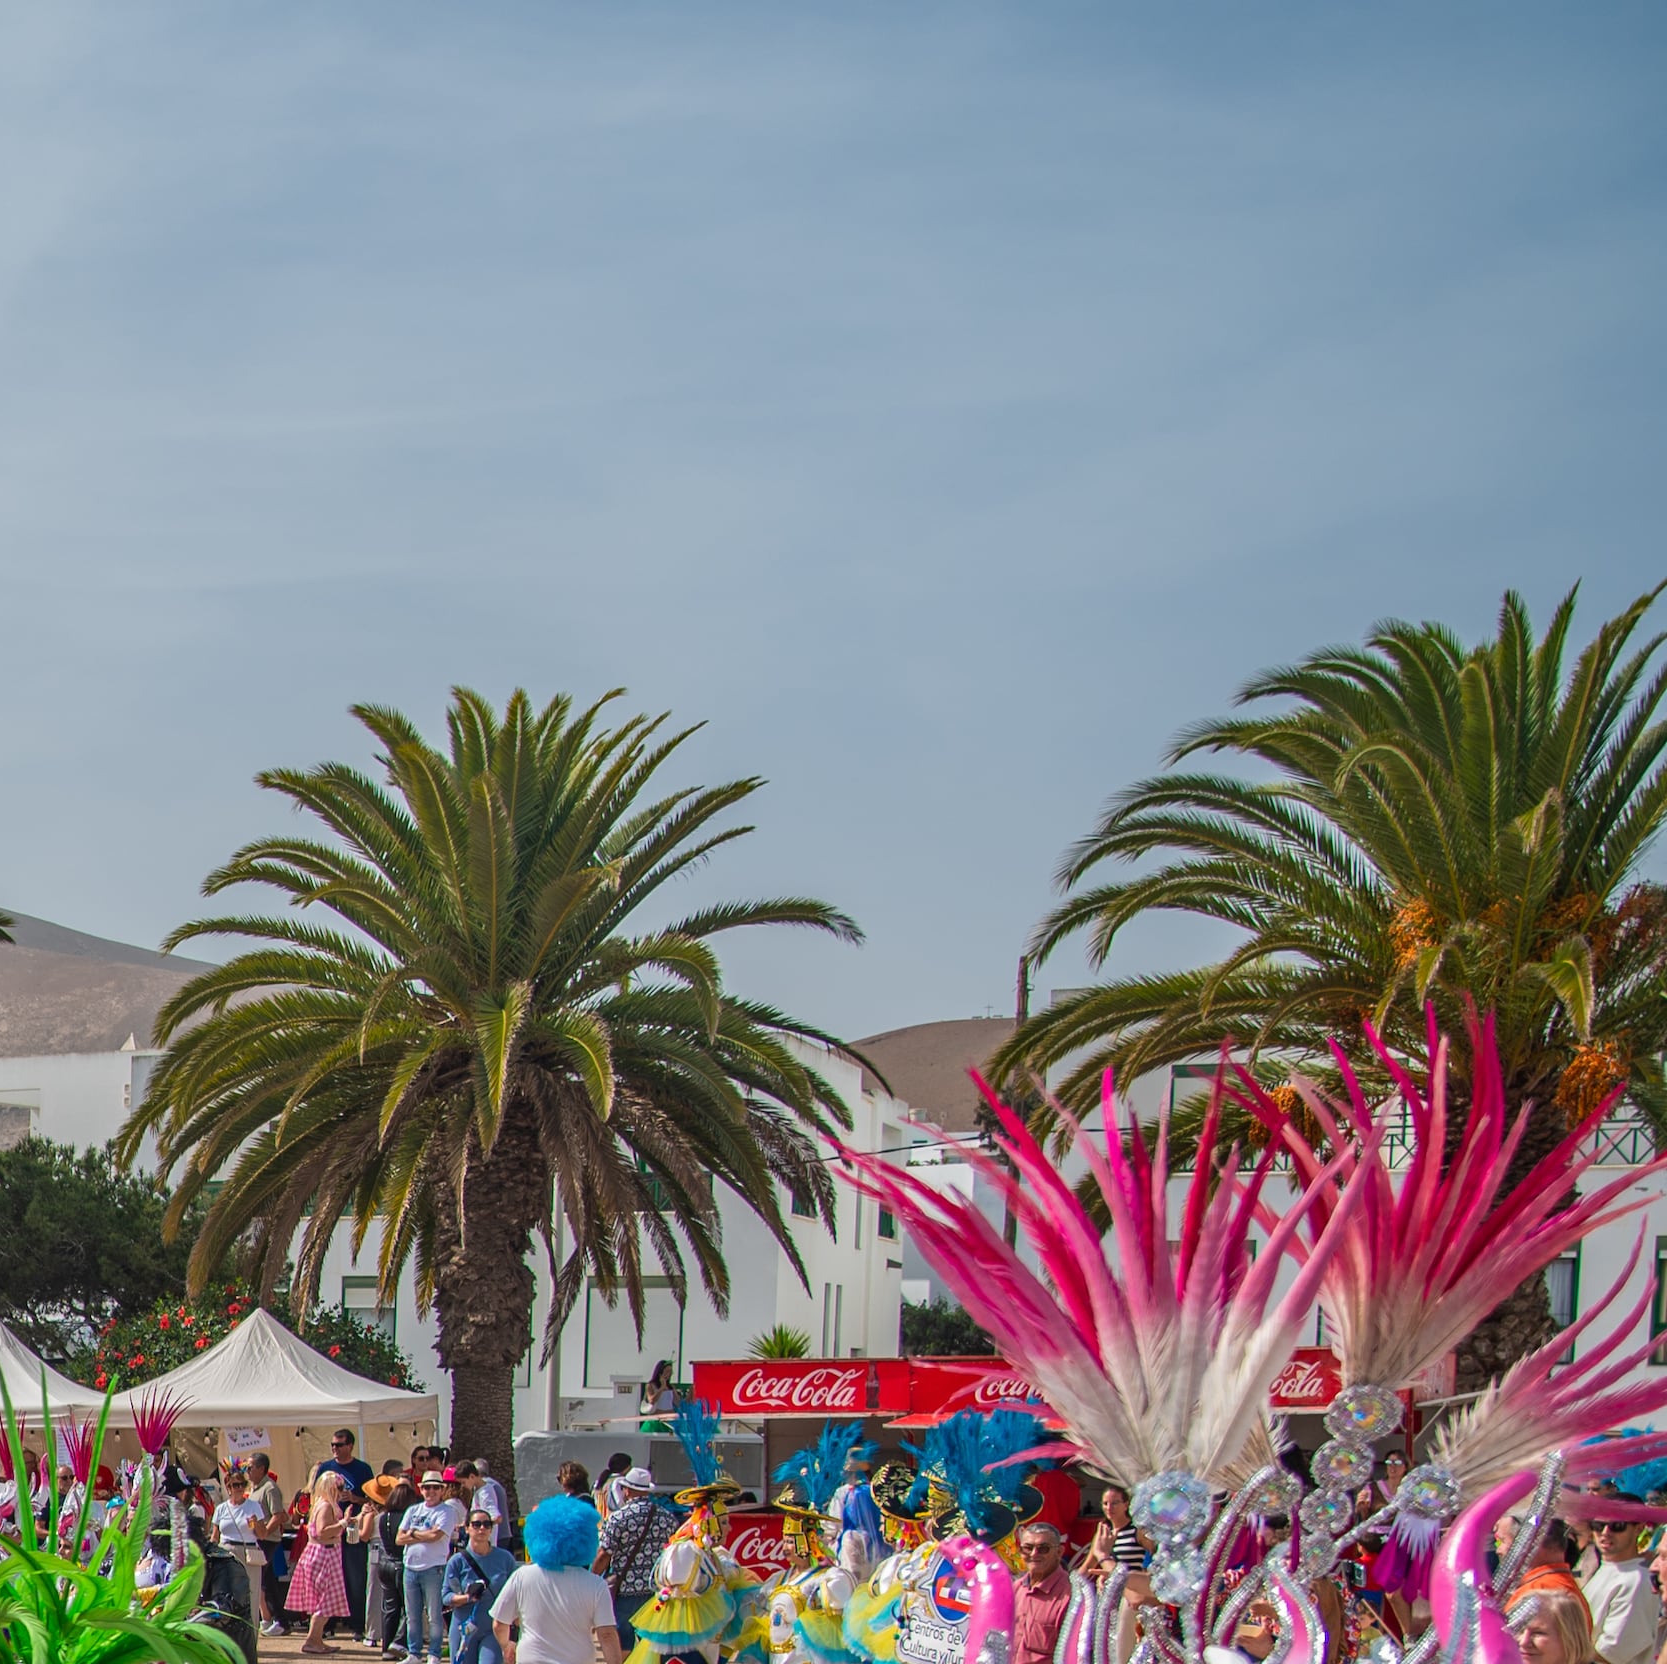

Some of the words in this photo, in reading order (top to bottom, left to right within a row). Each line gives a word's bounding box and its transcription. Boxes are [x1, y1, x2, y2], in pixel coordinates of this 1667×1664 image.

[732, 1368, 865, 1407] Coca-Cola
[908, 1616, 945, 1642] Centros
[948, 1628, 961, 1646] de
[901, 1637, 938, 1660] Cultura
